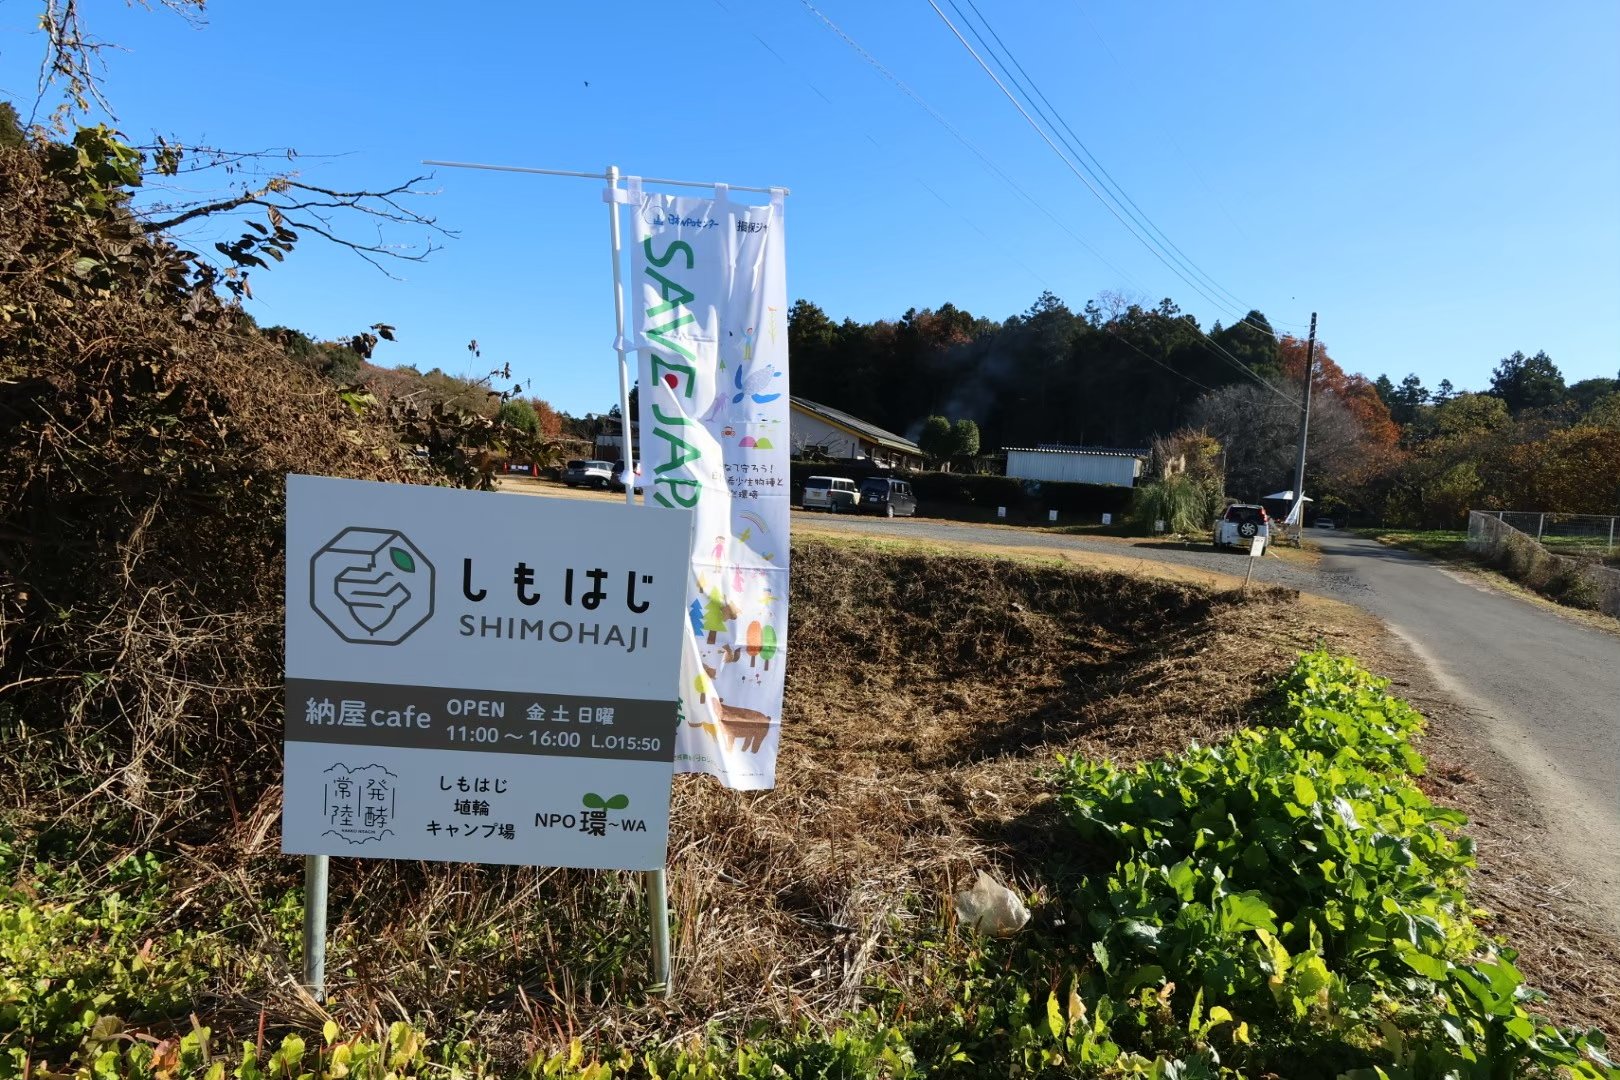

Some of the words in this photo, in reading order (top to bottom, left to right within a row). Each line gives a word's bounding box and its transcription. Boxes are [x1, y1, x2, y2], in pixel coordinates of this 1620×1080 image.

[643, 234, 696, 399] SAVE
[651, 403, 702, 508] JAP
[462, 557, 655, 614] しもはじ
[459, 614, 650, 653] SHIMOHAJI
[305, 697, 432, 730] 納屋cafe
[446, 698, 506, 719] OPEN
[439, 775, 508, 794] しもはじ
[453, 798, 490, 817] 埴輪
[426, 819, 516, 840] キャンプ場
